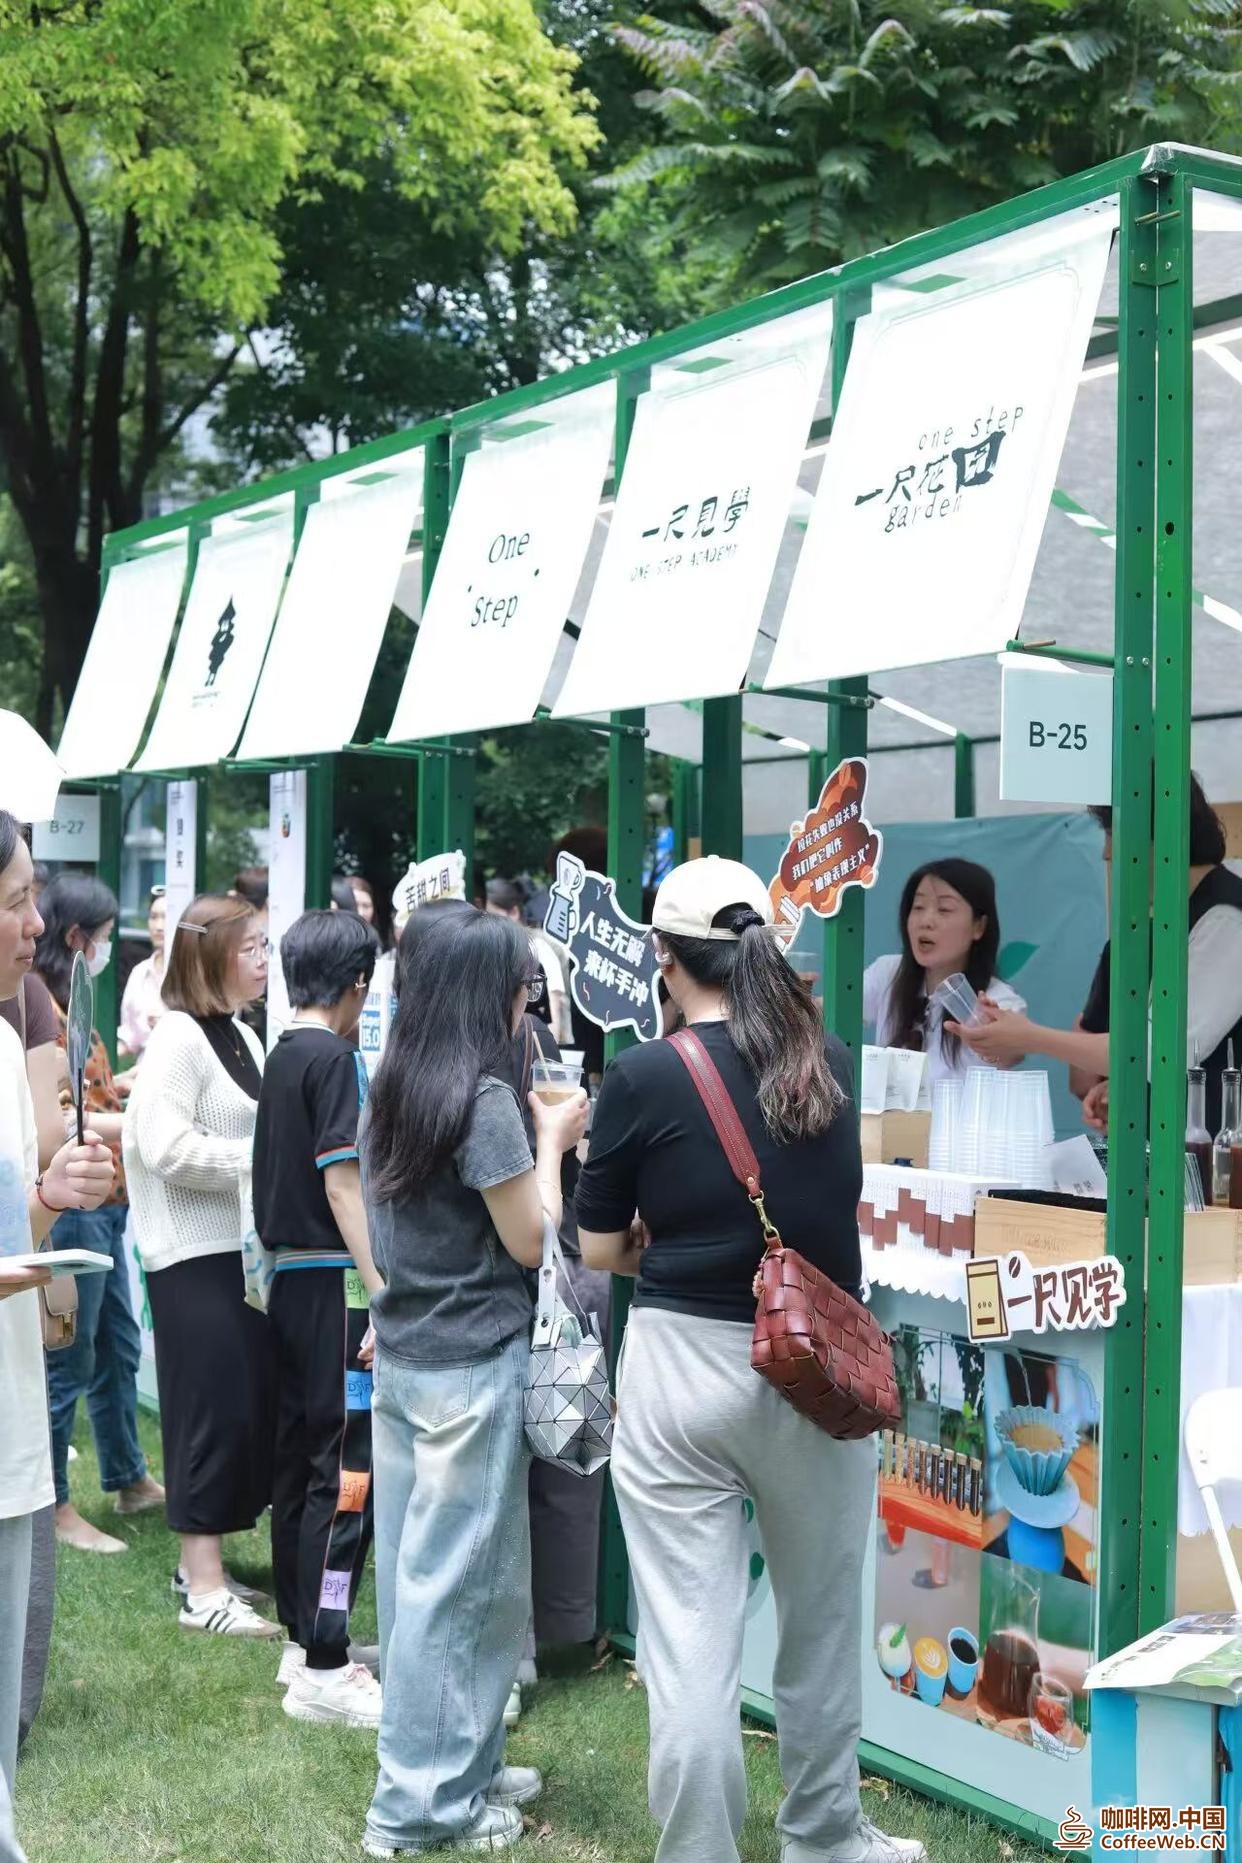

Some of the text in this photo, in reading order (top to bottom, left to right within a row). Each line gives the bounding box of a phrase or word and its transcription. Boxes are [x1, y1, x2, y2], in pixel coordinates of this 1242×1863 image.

[917, 405, 1024, 451] one step
[884, 493, 963, 533] garden
[488, 532, 531, 564] One
[470, 594, 519, 628] Step
[1029, 720, 1088, 751] B-25
[49, 819, 86, 835] B-27
[579, 910, 646, 968] 人生无解
[583, 948, 650, 1008] 来杯手冲
[1006, 1262, 1121, 1328] 一尺见学
